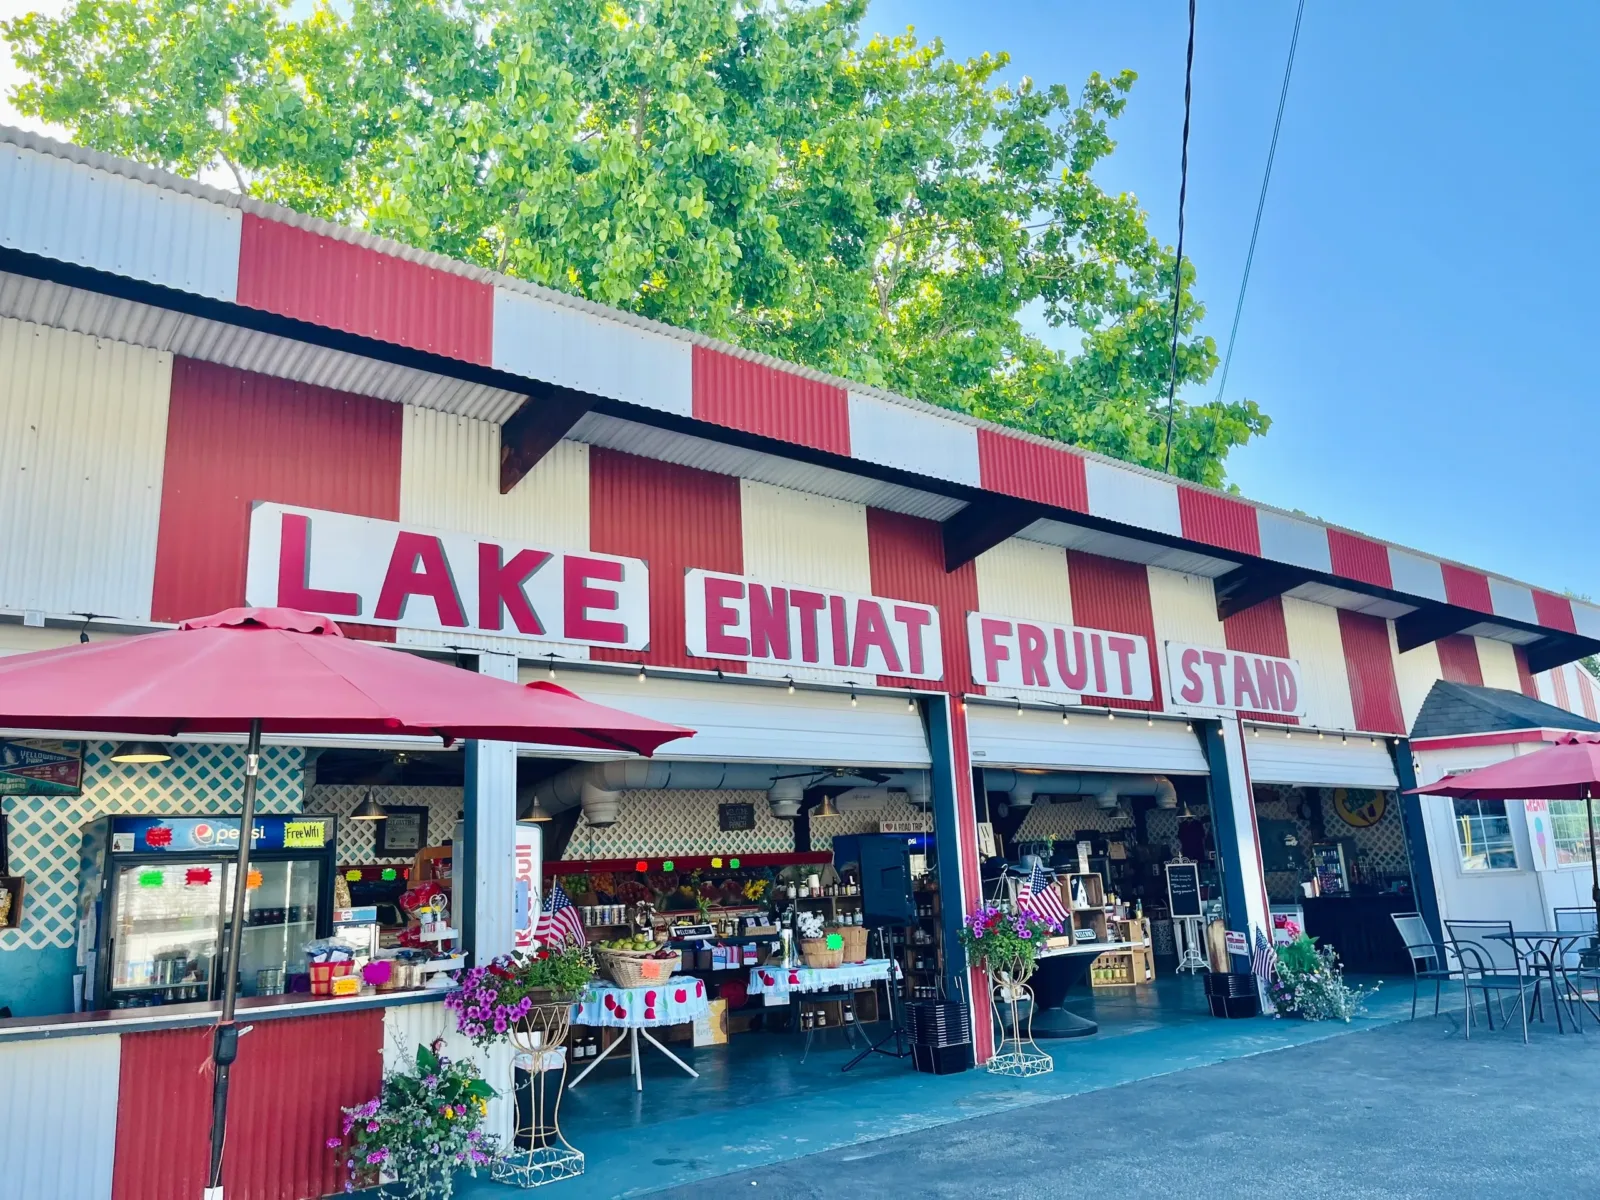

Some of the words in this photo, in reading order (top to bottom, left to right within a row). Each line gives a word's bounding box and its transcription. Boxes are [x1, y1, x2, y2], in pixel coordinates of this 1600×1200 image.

[276, 512, 631, 644] LAKE
[704, 575, 932, 674] ENTIAT
[981, 618, 1137, 695] FRUIT
[1180, 648, 1298, 713] STAND
[286, 826, 304, 839] Free
[898, 823, 912, 832] ROAD
[912, 822, 923, 832] TRIP
[216, 825, 266, 844] pesi
[676, 928, 697, 936] WELCOME
